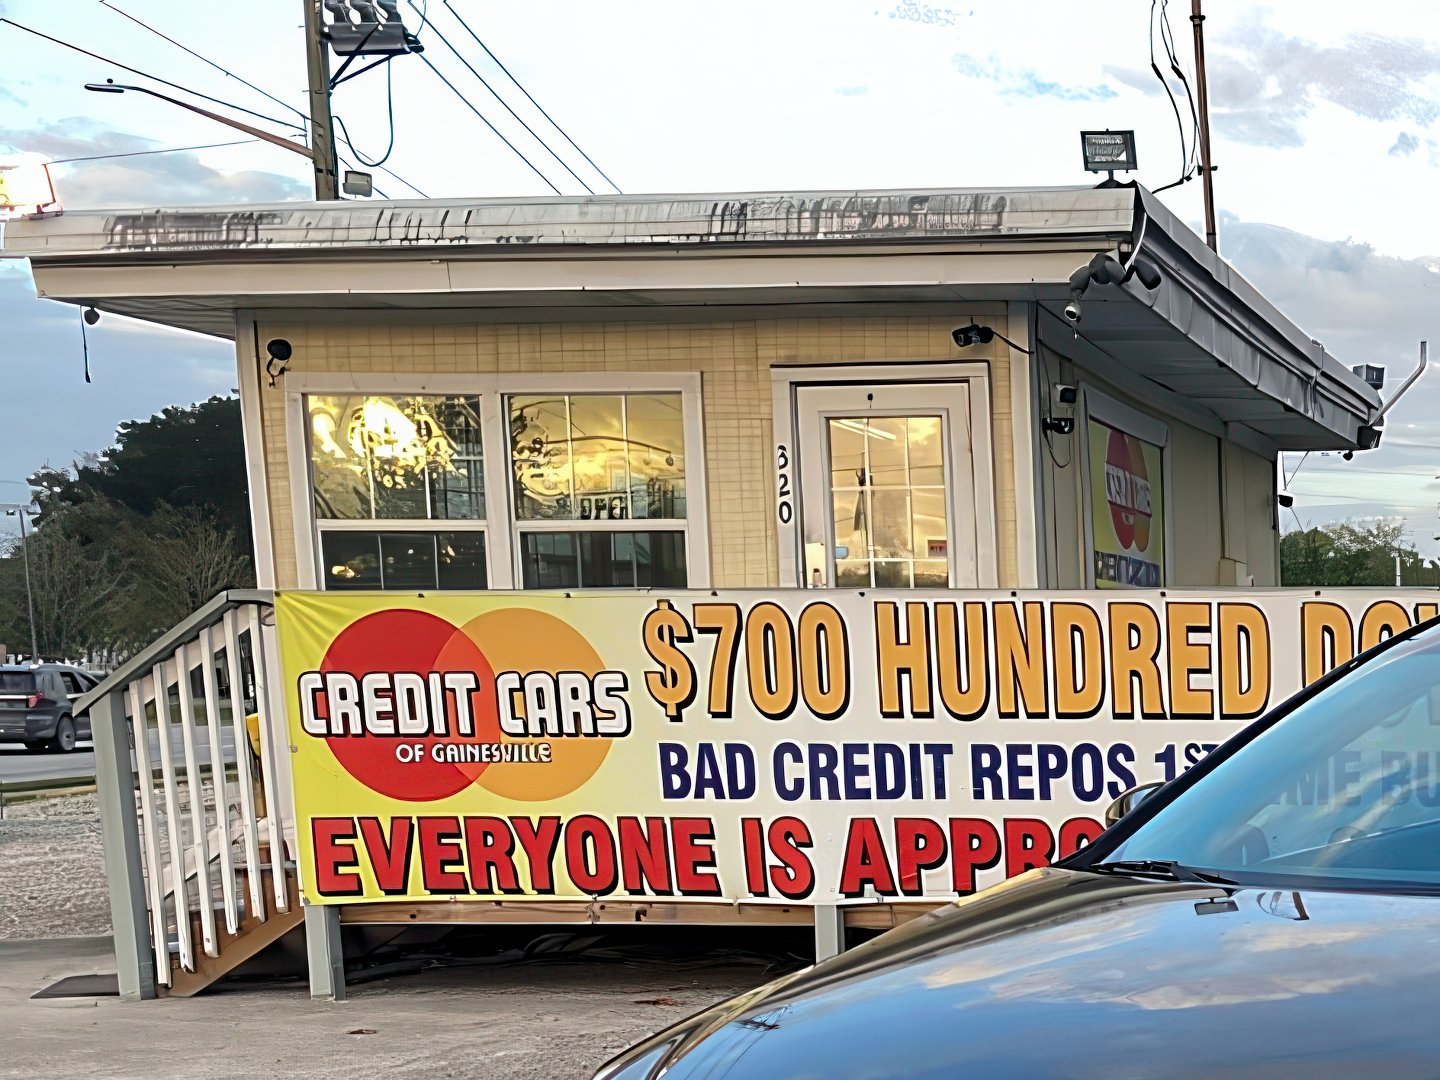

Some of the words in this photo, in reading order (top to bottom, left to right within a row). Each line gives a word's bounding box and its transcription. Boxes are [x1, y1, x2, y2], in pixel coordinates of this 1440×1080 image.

[643, 599, 851, 723] $700
[874, 600, 1272, 722] HUNDRED
[299, 670, 479, 738] CREDIT
[496, 670, 631, 738] CARS
[395, 743, 425, 763] OF
[431, 742, 553, 763] GAINESVILLE
[658, 742, 758, 801] BAD
[773, 743, 953, 800] CREDIT
[971, 742, 1137, 802] REPOS
[311, 815, 722, 897] EVERYONE
[742, 815, 815, 898] IS
